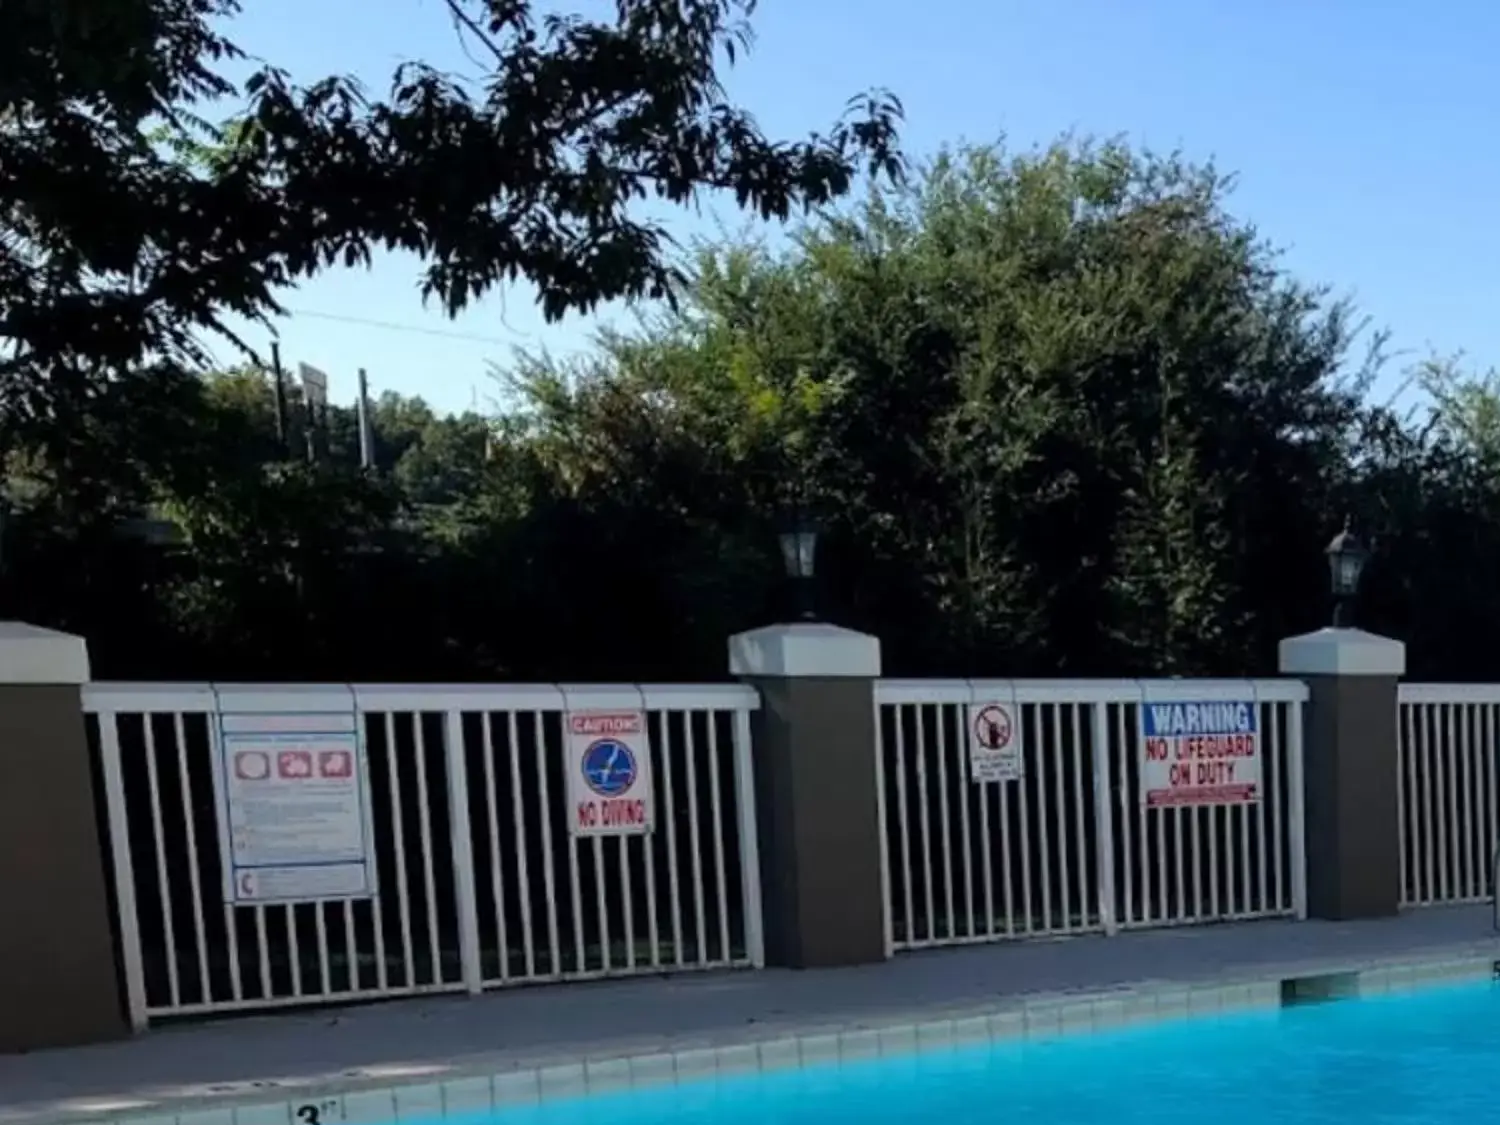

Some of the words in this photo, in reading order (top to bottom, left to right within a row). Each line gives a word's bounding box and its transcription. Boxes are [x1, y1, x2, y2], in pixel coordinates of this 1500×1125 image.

[1152, 703, 1249, 733] WARNING
[1146, 737, 1168, 760] NO
[1174, 734, 1254, 760] LIFEGUARD
[1170, 763, 1191, 785] ON
[1197, 761, 1234, 784] DUTY
[578, 801, 596, 828] NO
[601, 799, 645, 826] DIVING
